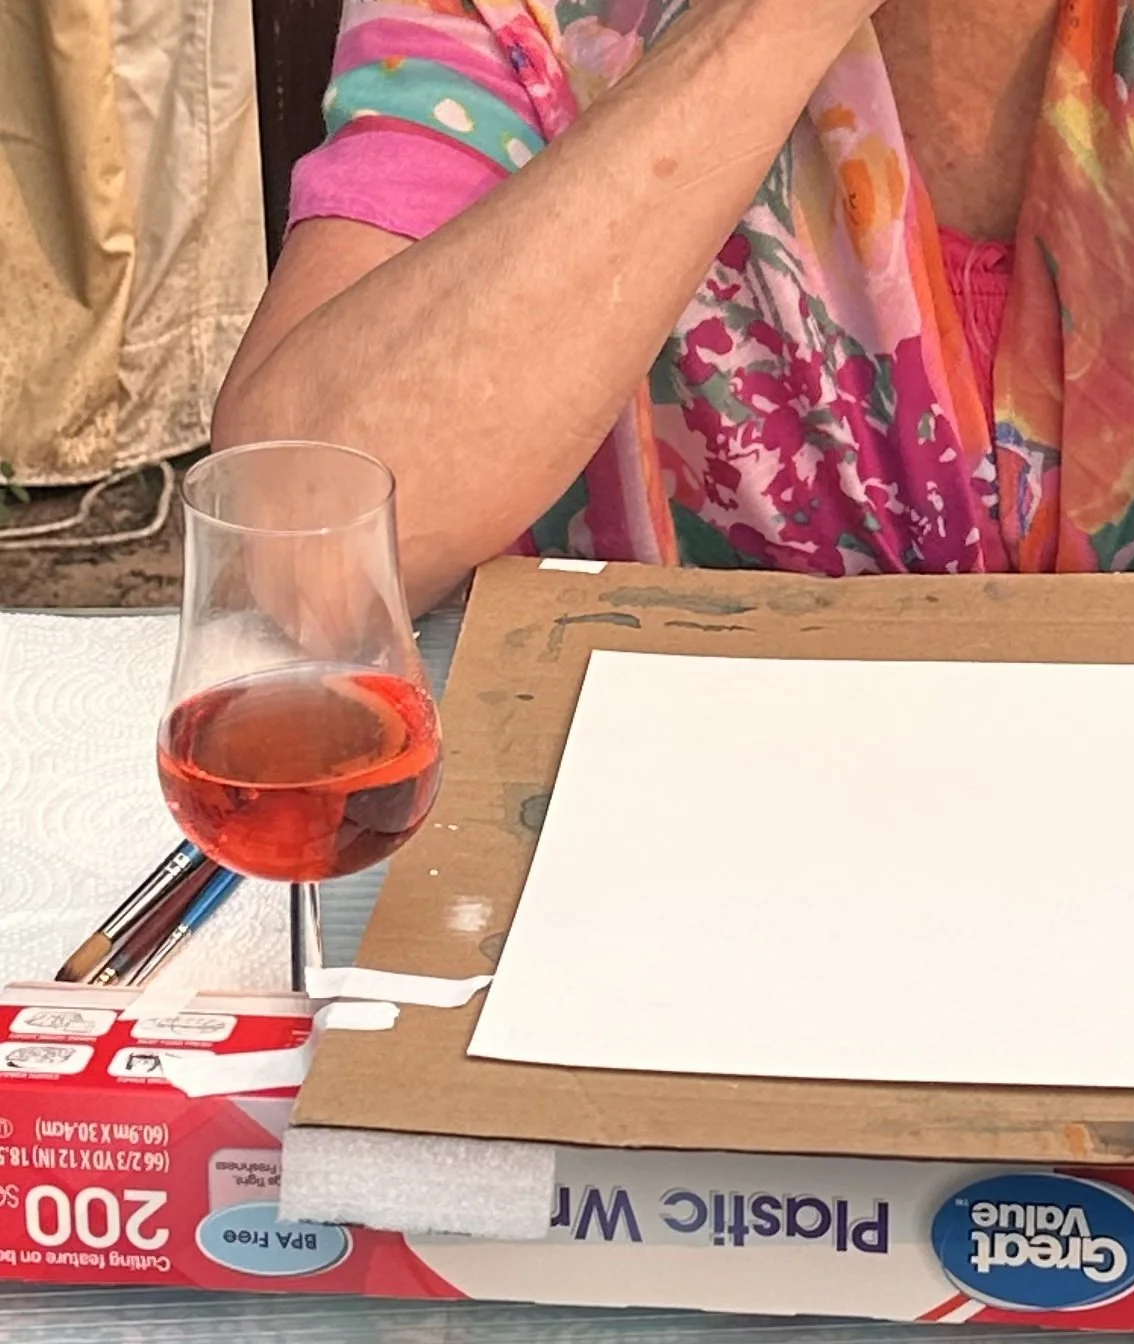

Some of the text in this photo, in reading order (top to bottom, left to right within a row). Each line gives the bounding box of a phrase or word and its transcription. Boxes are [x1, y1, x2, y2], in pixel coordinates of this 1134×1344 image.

[35, 1116, 170, 1146] (60.9m X 30.4cm)
[33, 1144, 57, 1169] IN)
[59, 1149, 78, 1169] 12
[80, 1149, 91, 1170] X
[93, 1150, 114, 1171] YD
[116, 1150, 141, 1171] 2/3
[144, 1150, 170, 1173] (66
[25, 1184, 170, 1251] 200
[550, 1187, 889, 1254] Plastic Wr
[971, 1202, 1091, 1237] Value
[222, 1229, 317, 1250] BPA Free
[20, 1249, 42, 1264] on
[46, 1251, 105, 1269] feature
[110, 1251, 171, 1272] Cutting
[970, 1231, 1128, 1283] Great
